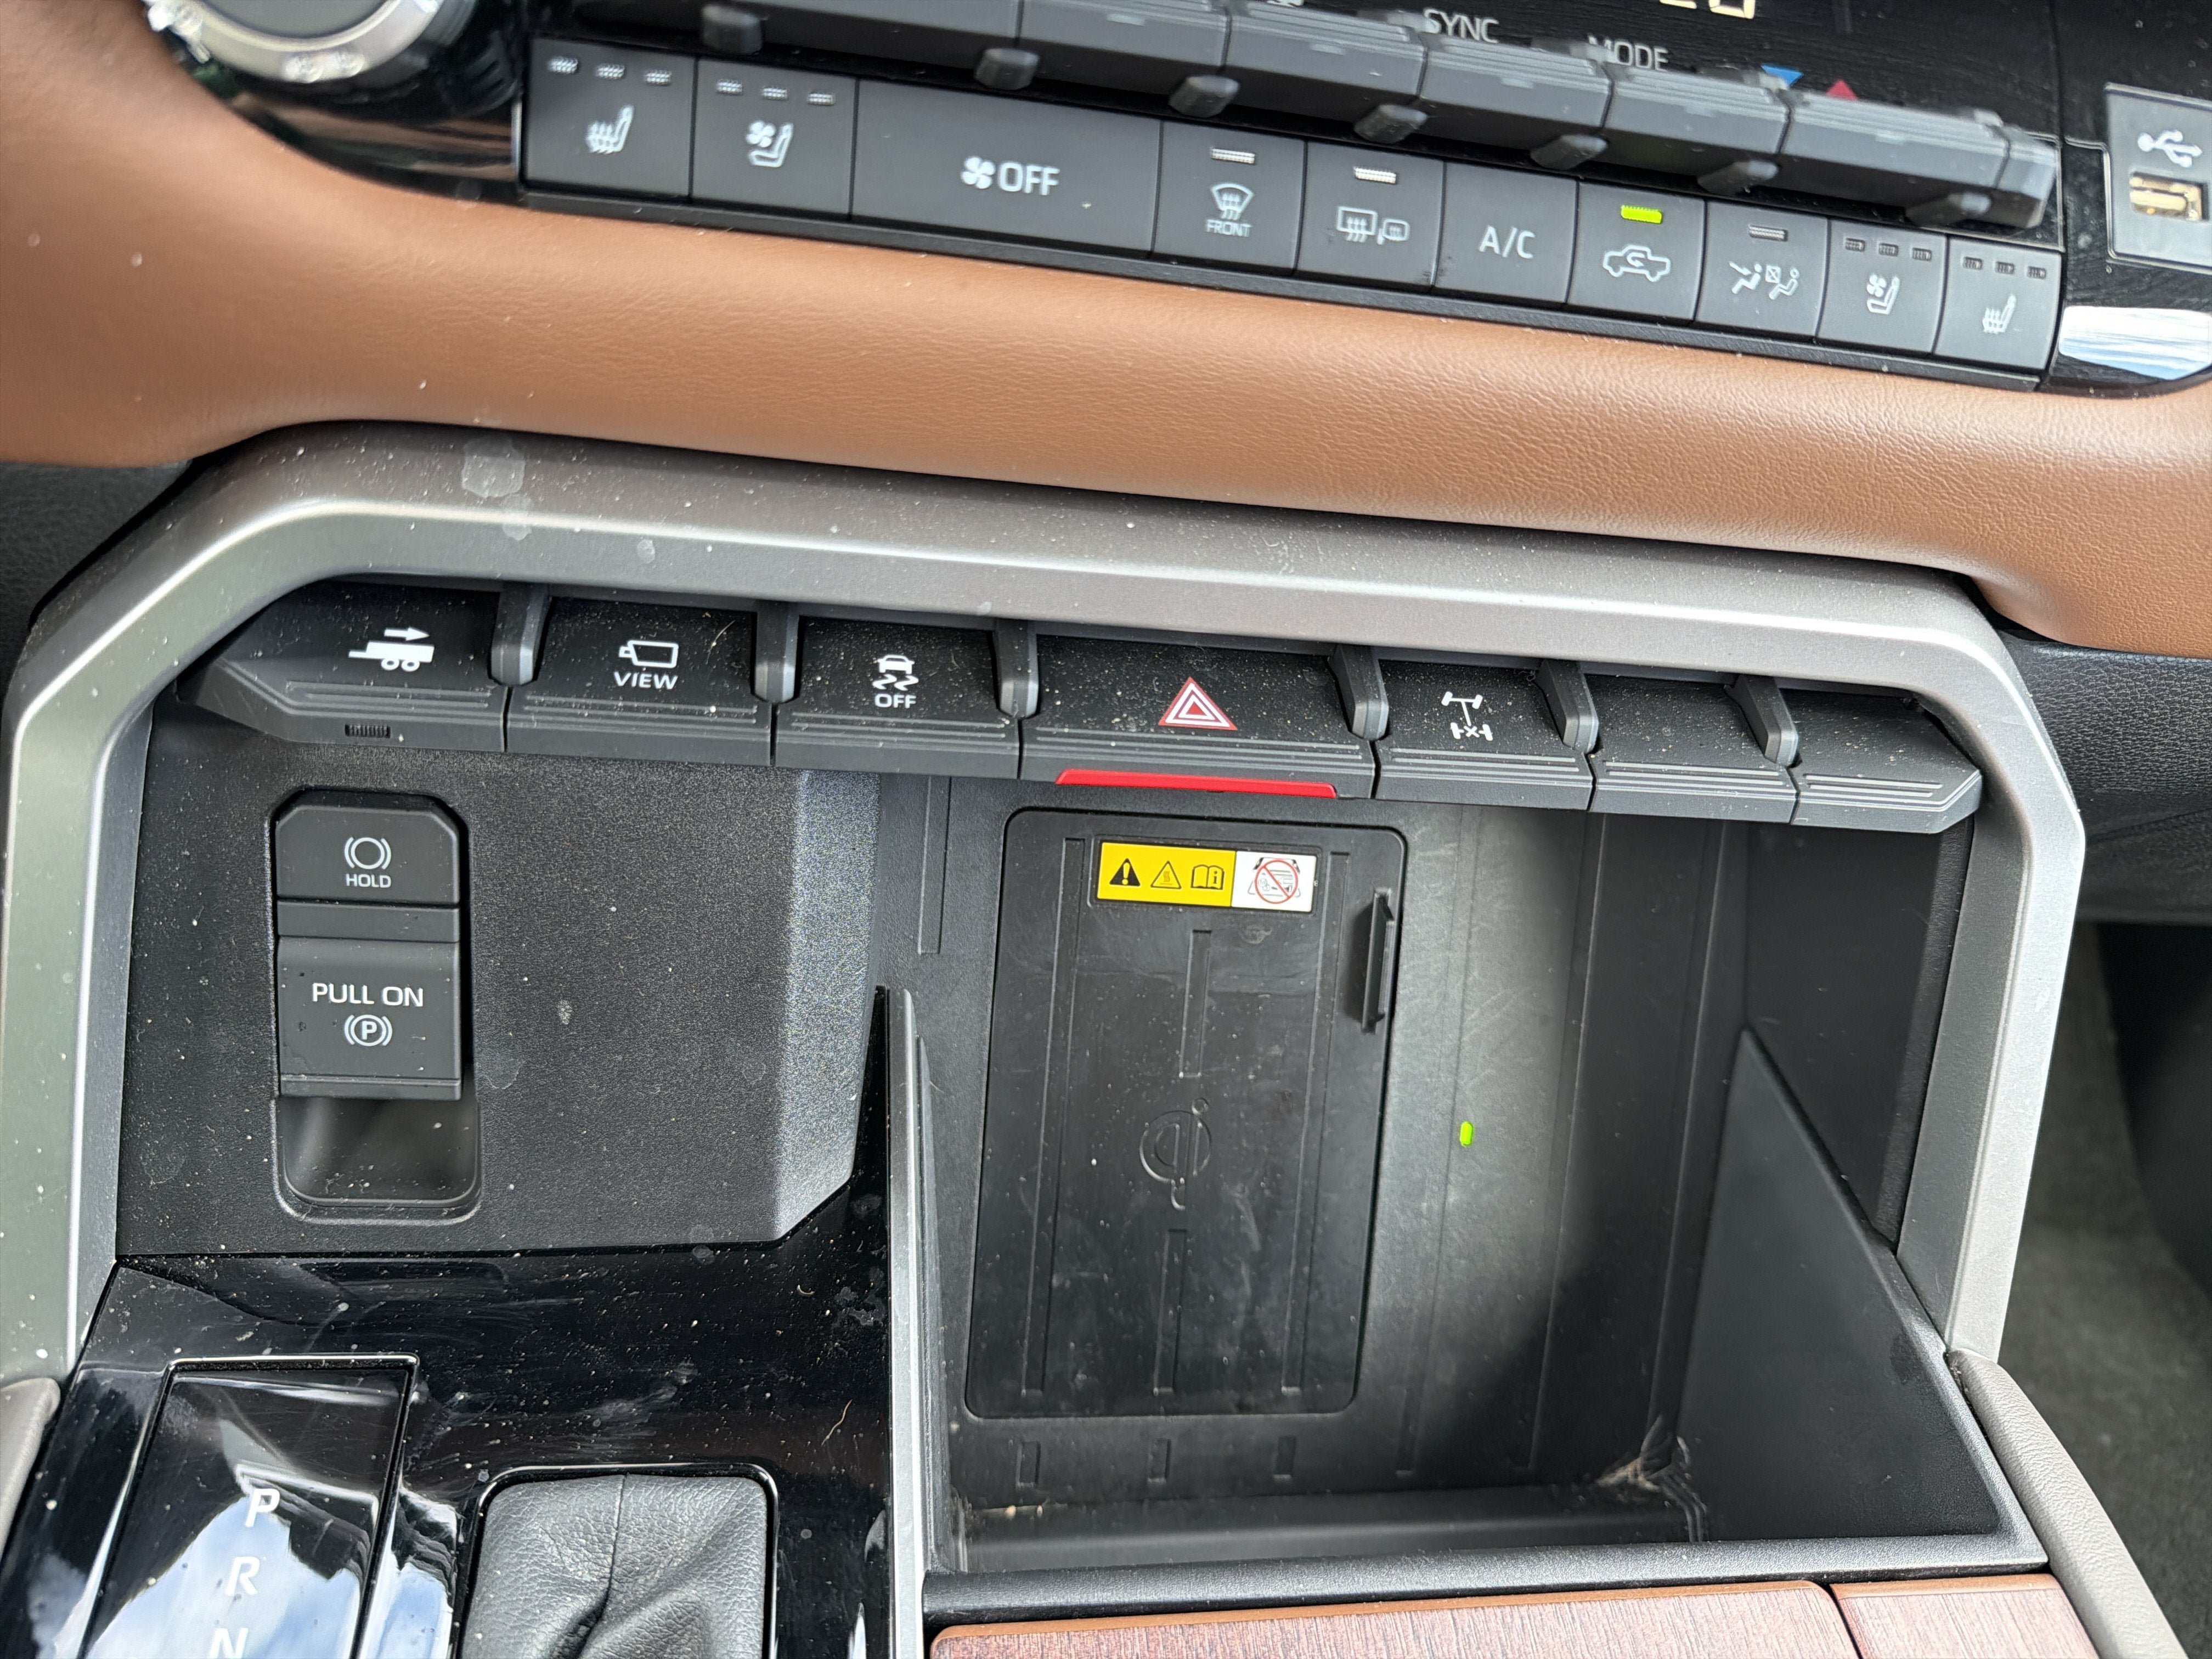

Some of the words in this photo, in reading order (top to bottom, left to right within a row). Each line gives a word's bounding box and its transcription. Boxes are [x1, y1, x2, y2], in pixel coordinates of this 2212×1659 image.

[1424, 8, 1499, 43] SYNC
[998, 162, 1060, 196] OFF
[1207, 219, 1252, 238] FRONT
[1479, 225, 1534, 259] A/C
[614, 672, 678, 690] VIEW
[875, 694, 916, 708] OFF
[346, 874, 392, 888] HOLD
[312, 983, 374, 1005] PULL
[382, 986, 424, 1007] ON
[361, 1020, 377, 1040] P
[245, 1488, 280, 1527] P
[227, 1556, 259, 1595] R
[208, 1627, 249, 1658] N
